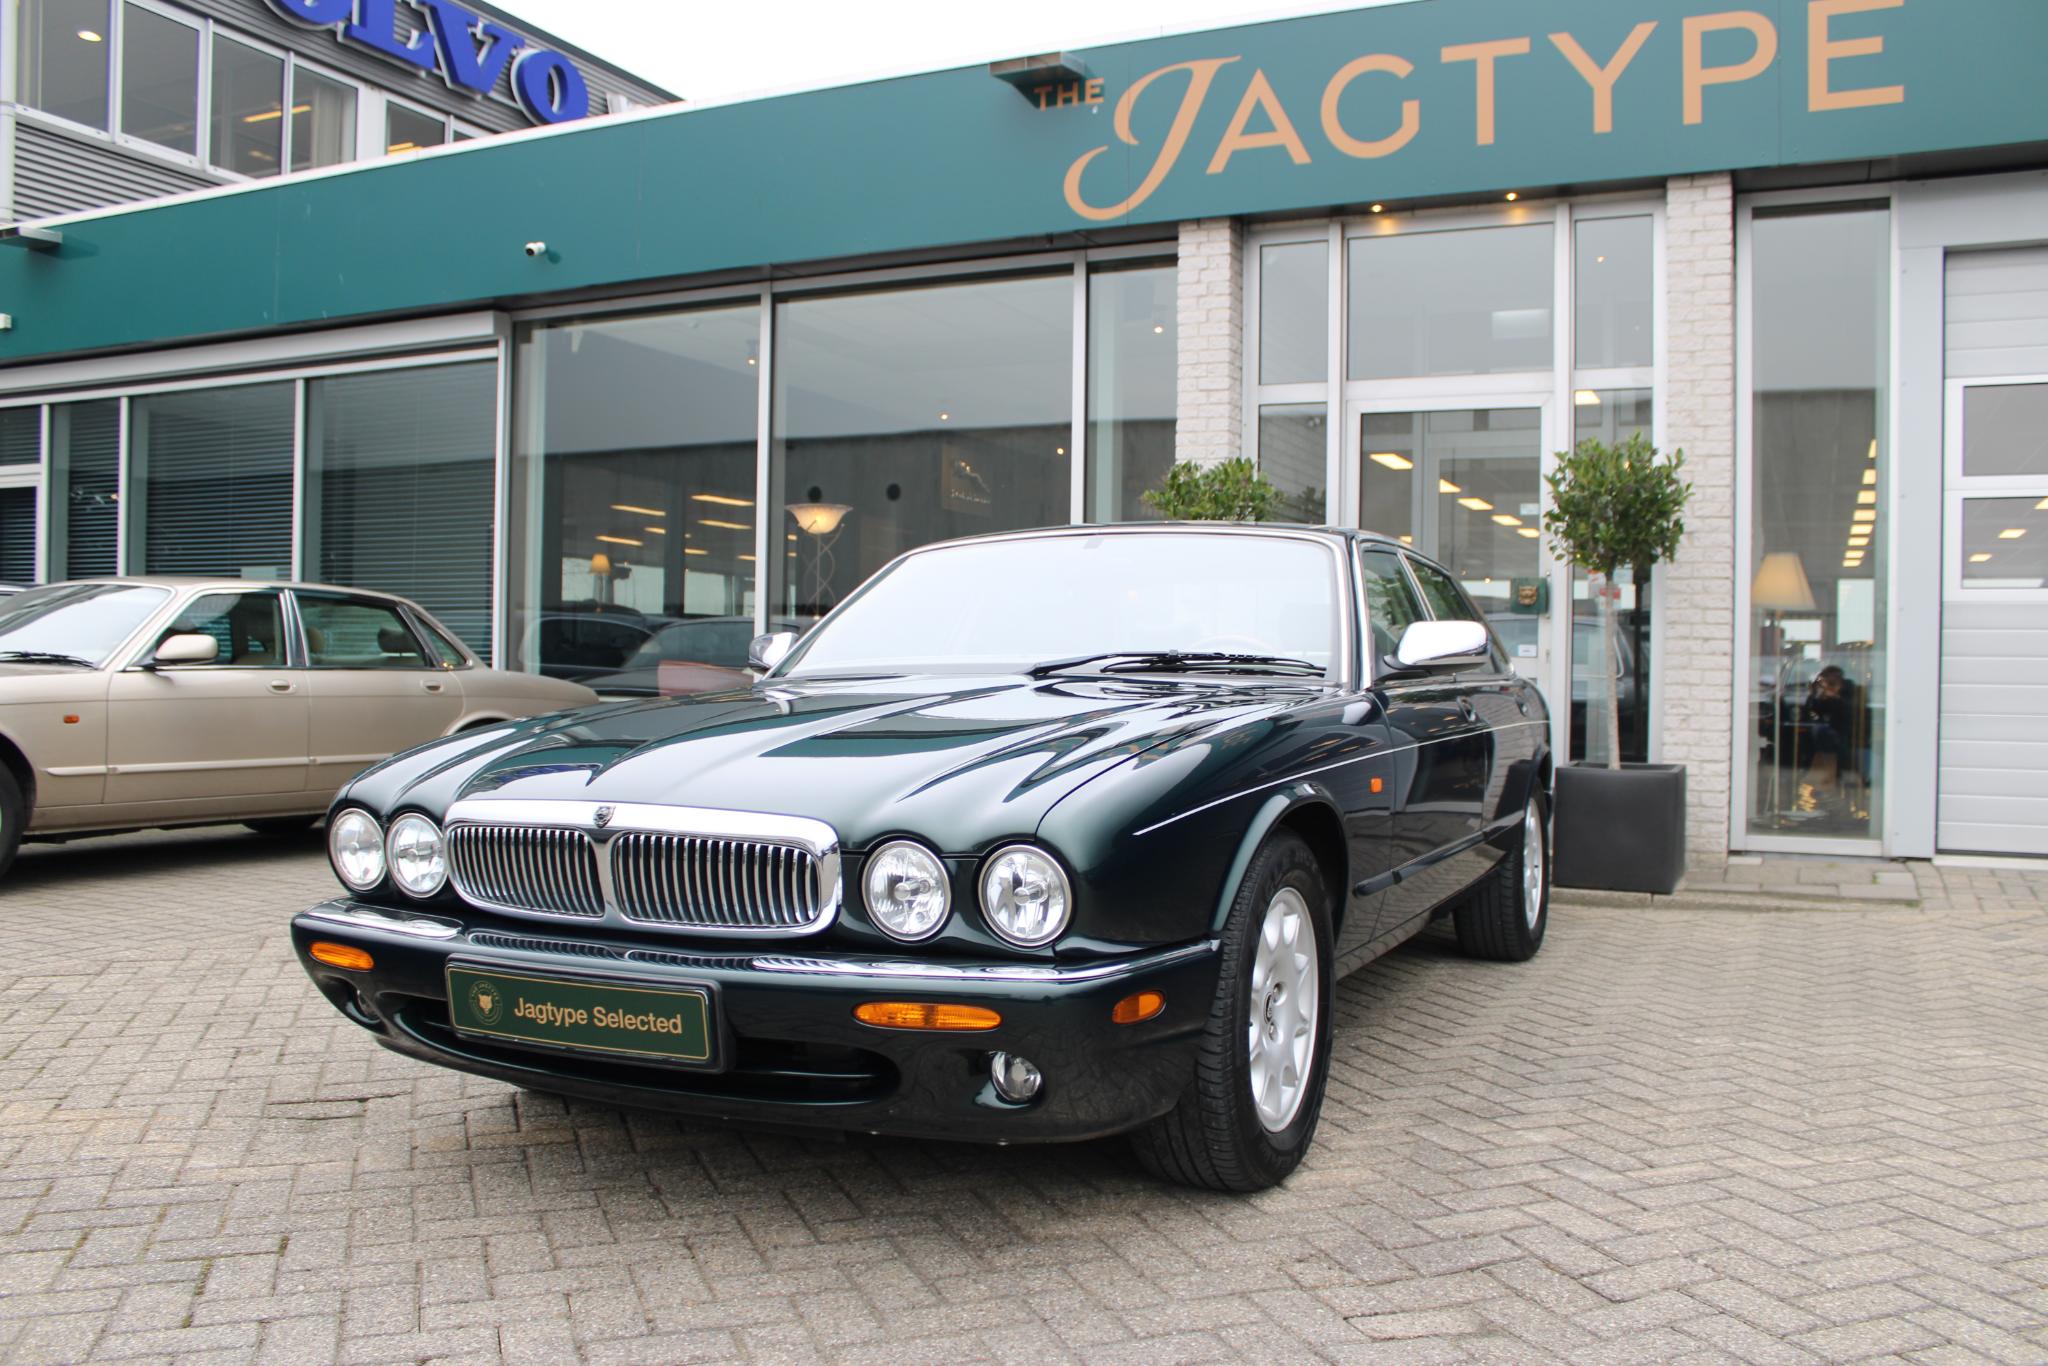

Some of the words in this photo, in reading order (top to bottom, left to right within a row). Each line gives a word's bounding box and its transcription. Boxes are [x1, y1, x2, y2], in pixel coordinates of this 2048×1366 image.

[264, 0, 590, 125] LVO
[1035, 78, 1104, 111] THE
[1063, 0, 1904, 221] JAGTYPE
[514, 997, 588, 1027] Jagtype
[593, 1006, 682, 1034] Selected
